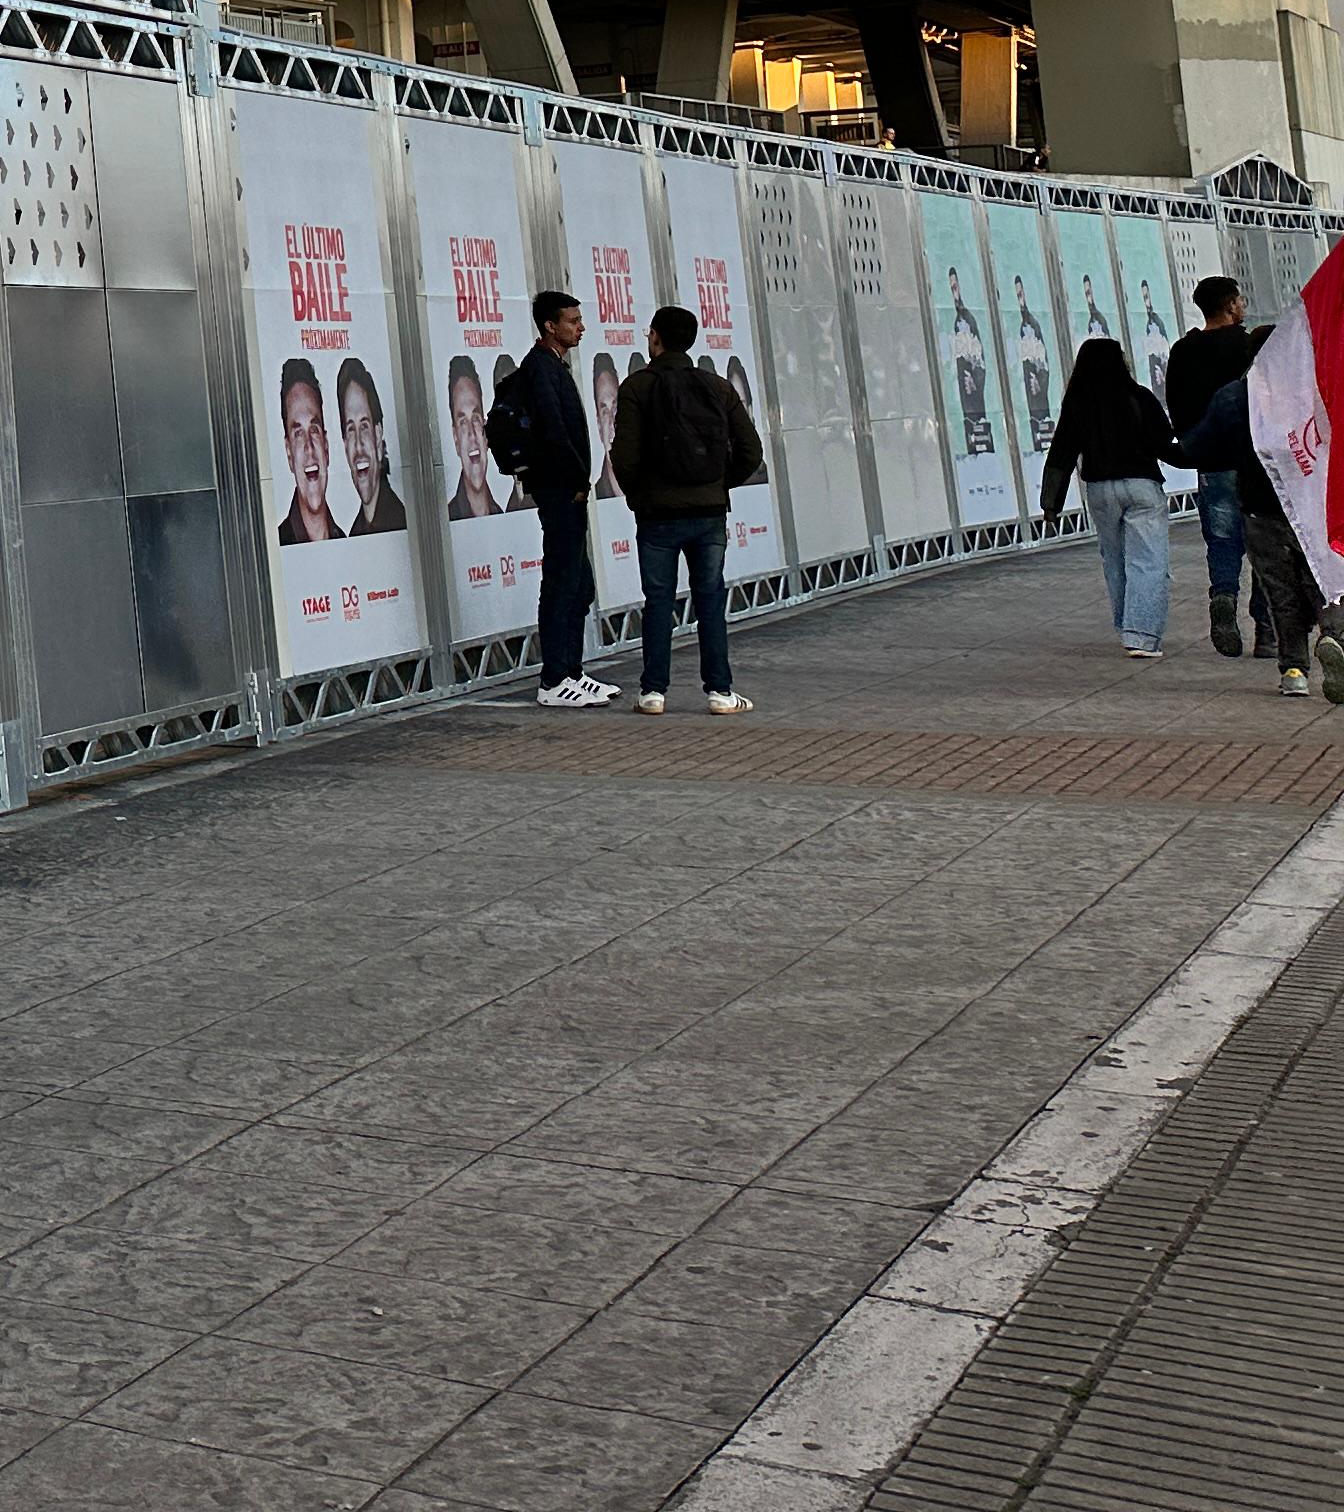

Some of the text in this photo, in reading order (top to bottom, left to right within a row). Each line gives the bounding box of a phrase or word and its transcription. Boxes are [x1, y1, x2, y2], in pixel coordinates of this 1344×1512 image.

[284, 222, 345, 261] EL ÚLTIMO
[449, 236, 464, 267] EL
[592, 246, 604, 274] EL
[288, 261, 352, 322] BAILE
[453, 269, 504, 323] BAILE
[594, 275, 636, 324] BAILE
[698, 284, 733, 329] BAILE
[468, 564, 492, 582] STAGE
[302, 595, 331, 616] STAGE
[341, 585, 359, 608] DG
